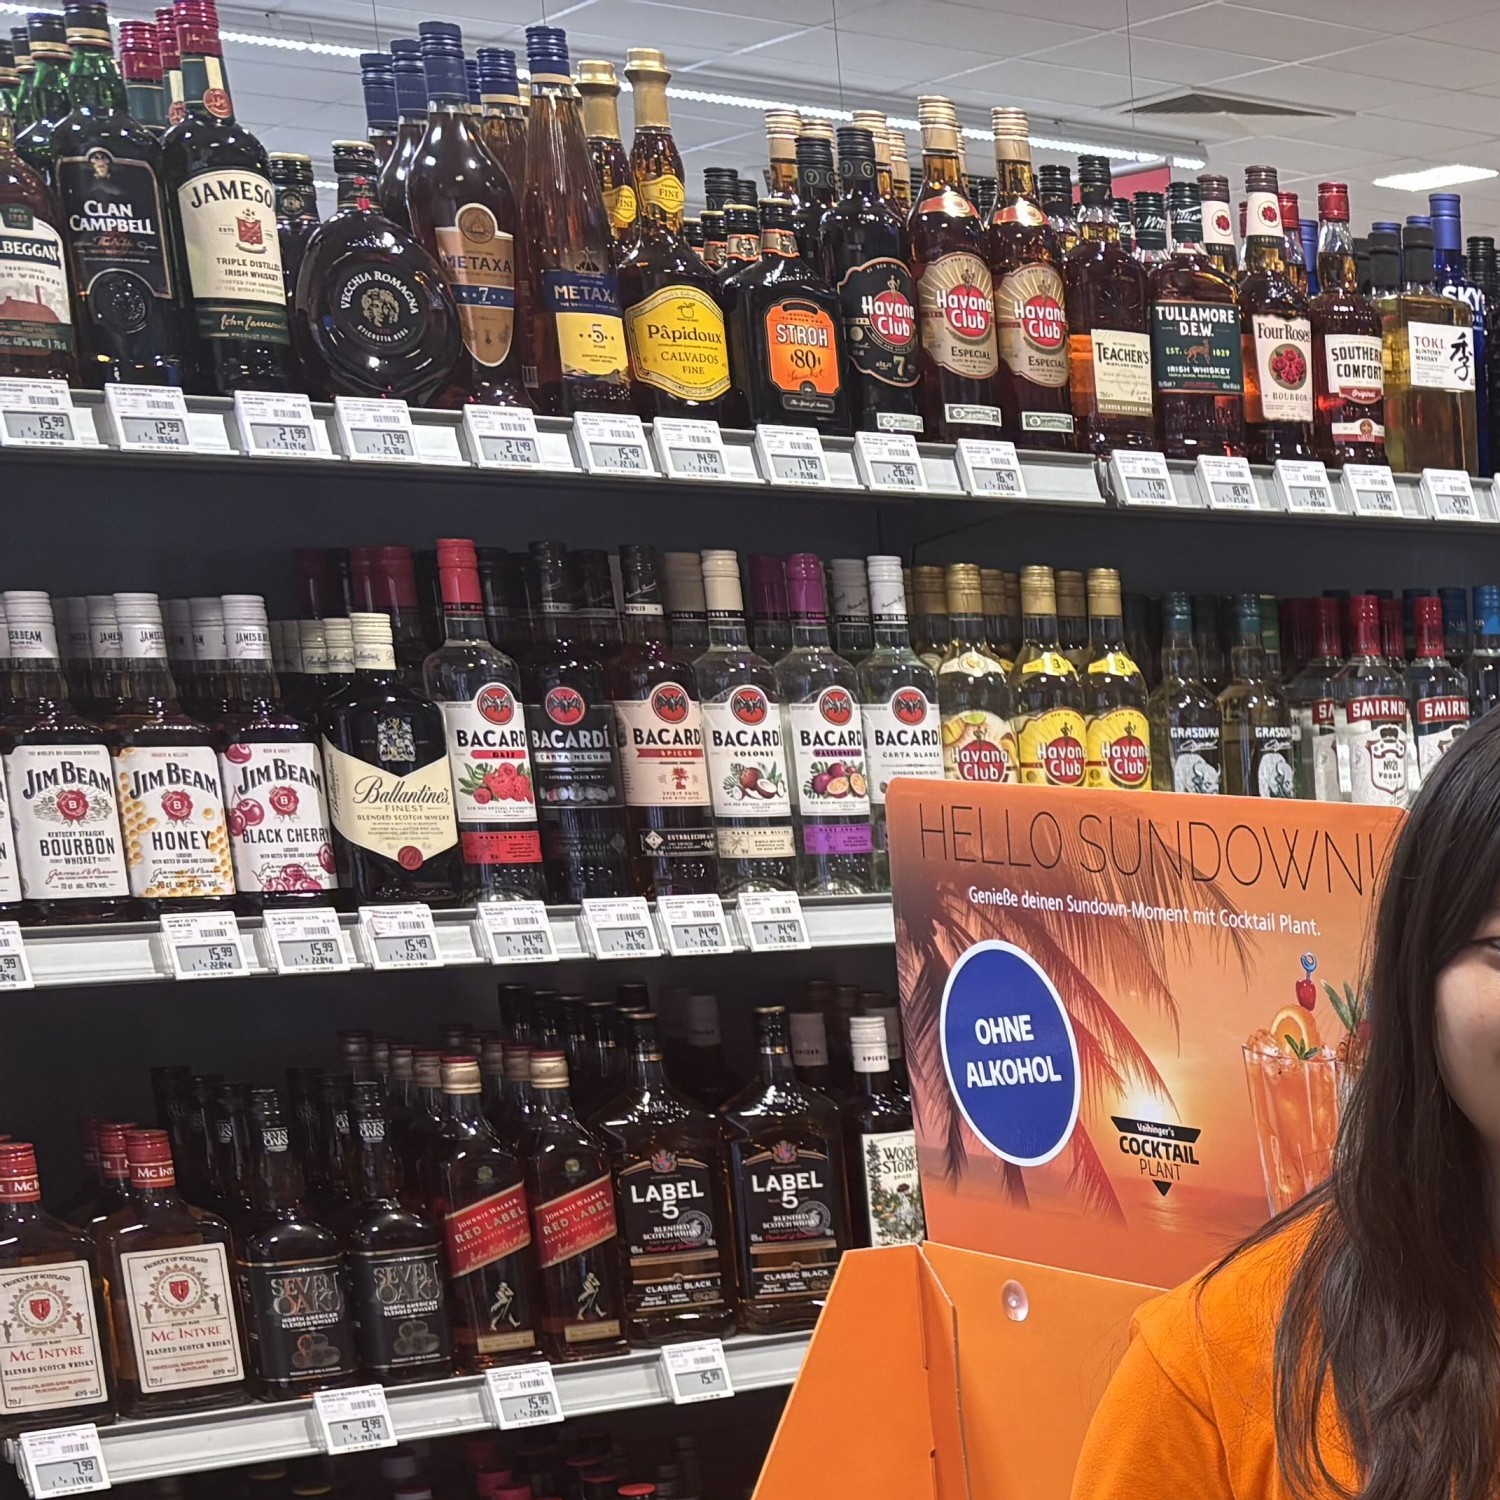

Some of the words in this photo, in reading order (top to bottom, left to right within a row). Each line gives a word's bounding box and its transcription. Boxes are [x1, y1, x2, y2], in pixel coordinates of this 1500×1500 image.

[84, 200, 133, 217] CLAN
[70, 215, 155, 234] CAMPBELL
[444, 254, 513, 273] METAXA
[341, 272, 371, 311] VECCHIA
[373, 270, 418, 315] ROMAGNA
[936, 289, 991, 313] Havana
[861, 295, 915, 319] Havana
[1156, 306, 1235, 324] TULLAMORE
[876, 316, 910, 337] Club
[951, 311, 985, 330] Club
[1180, 322, 1214, 337] D.E.W.
[647, 321, 722, 346] Pâpidoux
[775, 324, 829, 347] STROH
[1258, 322, 1283, 339] Four
[1285, 325, 1310, 343] Roses
[1413, 335, 1444, 349] TOKI
[660, 351, 720, 365] CALVADOS
[795, 349, 816, 370] 80
[951, 345, 991, 360] ESPECIAL
[1095, 342, 1151, 365] TEACHER'S
[1166, 347, 1182, 355] EST.
[1213, 348, 1230, 357] 1829
[1449, 331, 1473, 382] 季
[682, 365, 705, 375] FINE
[1167, 366, 1190, 374] IRISH
[1193, 366, 1230, 374] WHISKEY
[1337, 364, 1382, 381] COMFORT
[1272, 392, 1308, 401] BOURBON
[531, 726, 612, 749] BACARDÍ
[950, 747, 1009, 765] Havana
[22, 763, 57, 799] JIM
[61, 762, 112, 794] BEAM
[129, 769, 162, 796] JIM
[166, 761, 218, 797] BEAM
[237, 764, 271, 795] JIM
[275, 759, 321, 793] BEAM
[963, 761, 1000, 782] Club
[353, 775, 450, 806] Ballantine's
[384, 804, 424, 813] FINEST
[39, 836, 116, 857] BOURBON
[151, 830, 211, 851] HONEY
[242, 829, 284, 844] BLACK
[288, 828, 331, 844] CHERRY
[919, 803, 1063, 871] HELLO
[968, 885, 1019, 907] Genieße
[1021, 890, 1064, 912] deinen
[1066, 895, 1190, 924] Sundown-Moment
[1193, 906, 1217, 926] mit
[1220, 909, 1276, 932] Cocktail
[1280, 913, 1321, 937] Plant.
[974, 1014, 1034, 1047] OHNE
[966, 1055, 1062, 1089] ALKOHOL
[1136, 1122, 1175, 1137] Vaihinger's
[1119, 1135, 1200, 1165] COCKTAIL
[1139, 1159, 1182, 1182] PLANT
[631, 1179, 704, 1204] LABEL
[752, 1171, 823, 1193] LABEL
[662, 1200, 679, 1220] 5
[782, 1190, 799, 1209] 5
[543, 1218, 569, 1236] RED
[572, 1200, 611, 1222] LABEL
[645, 1284, 682, 1294] CLASSIC
[684, 1280, 711, 1289] BLACK
[39, 1345, 85, 1359] INTYRE
